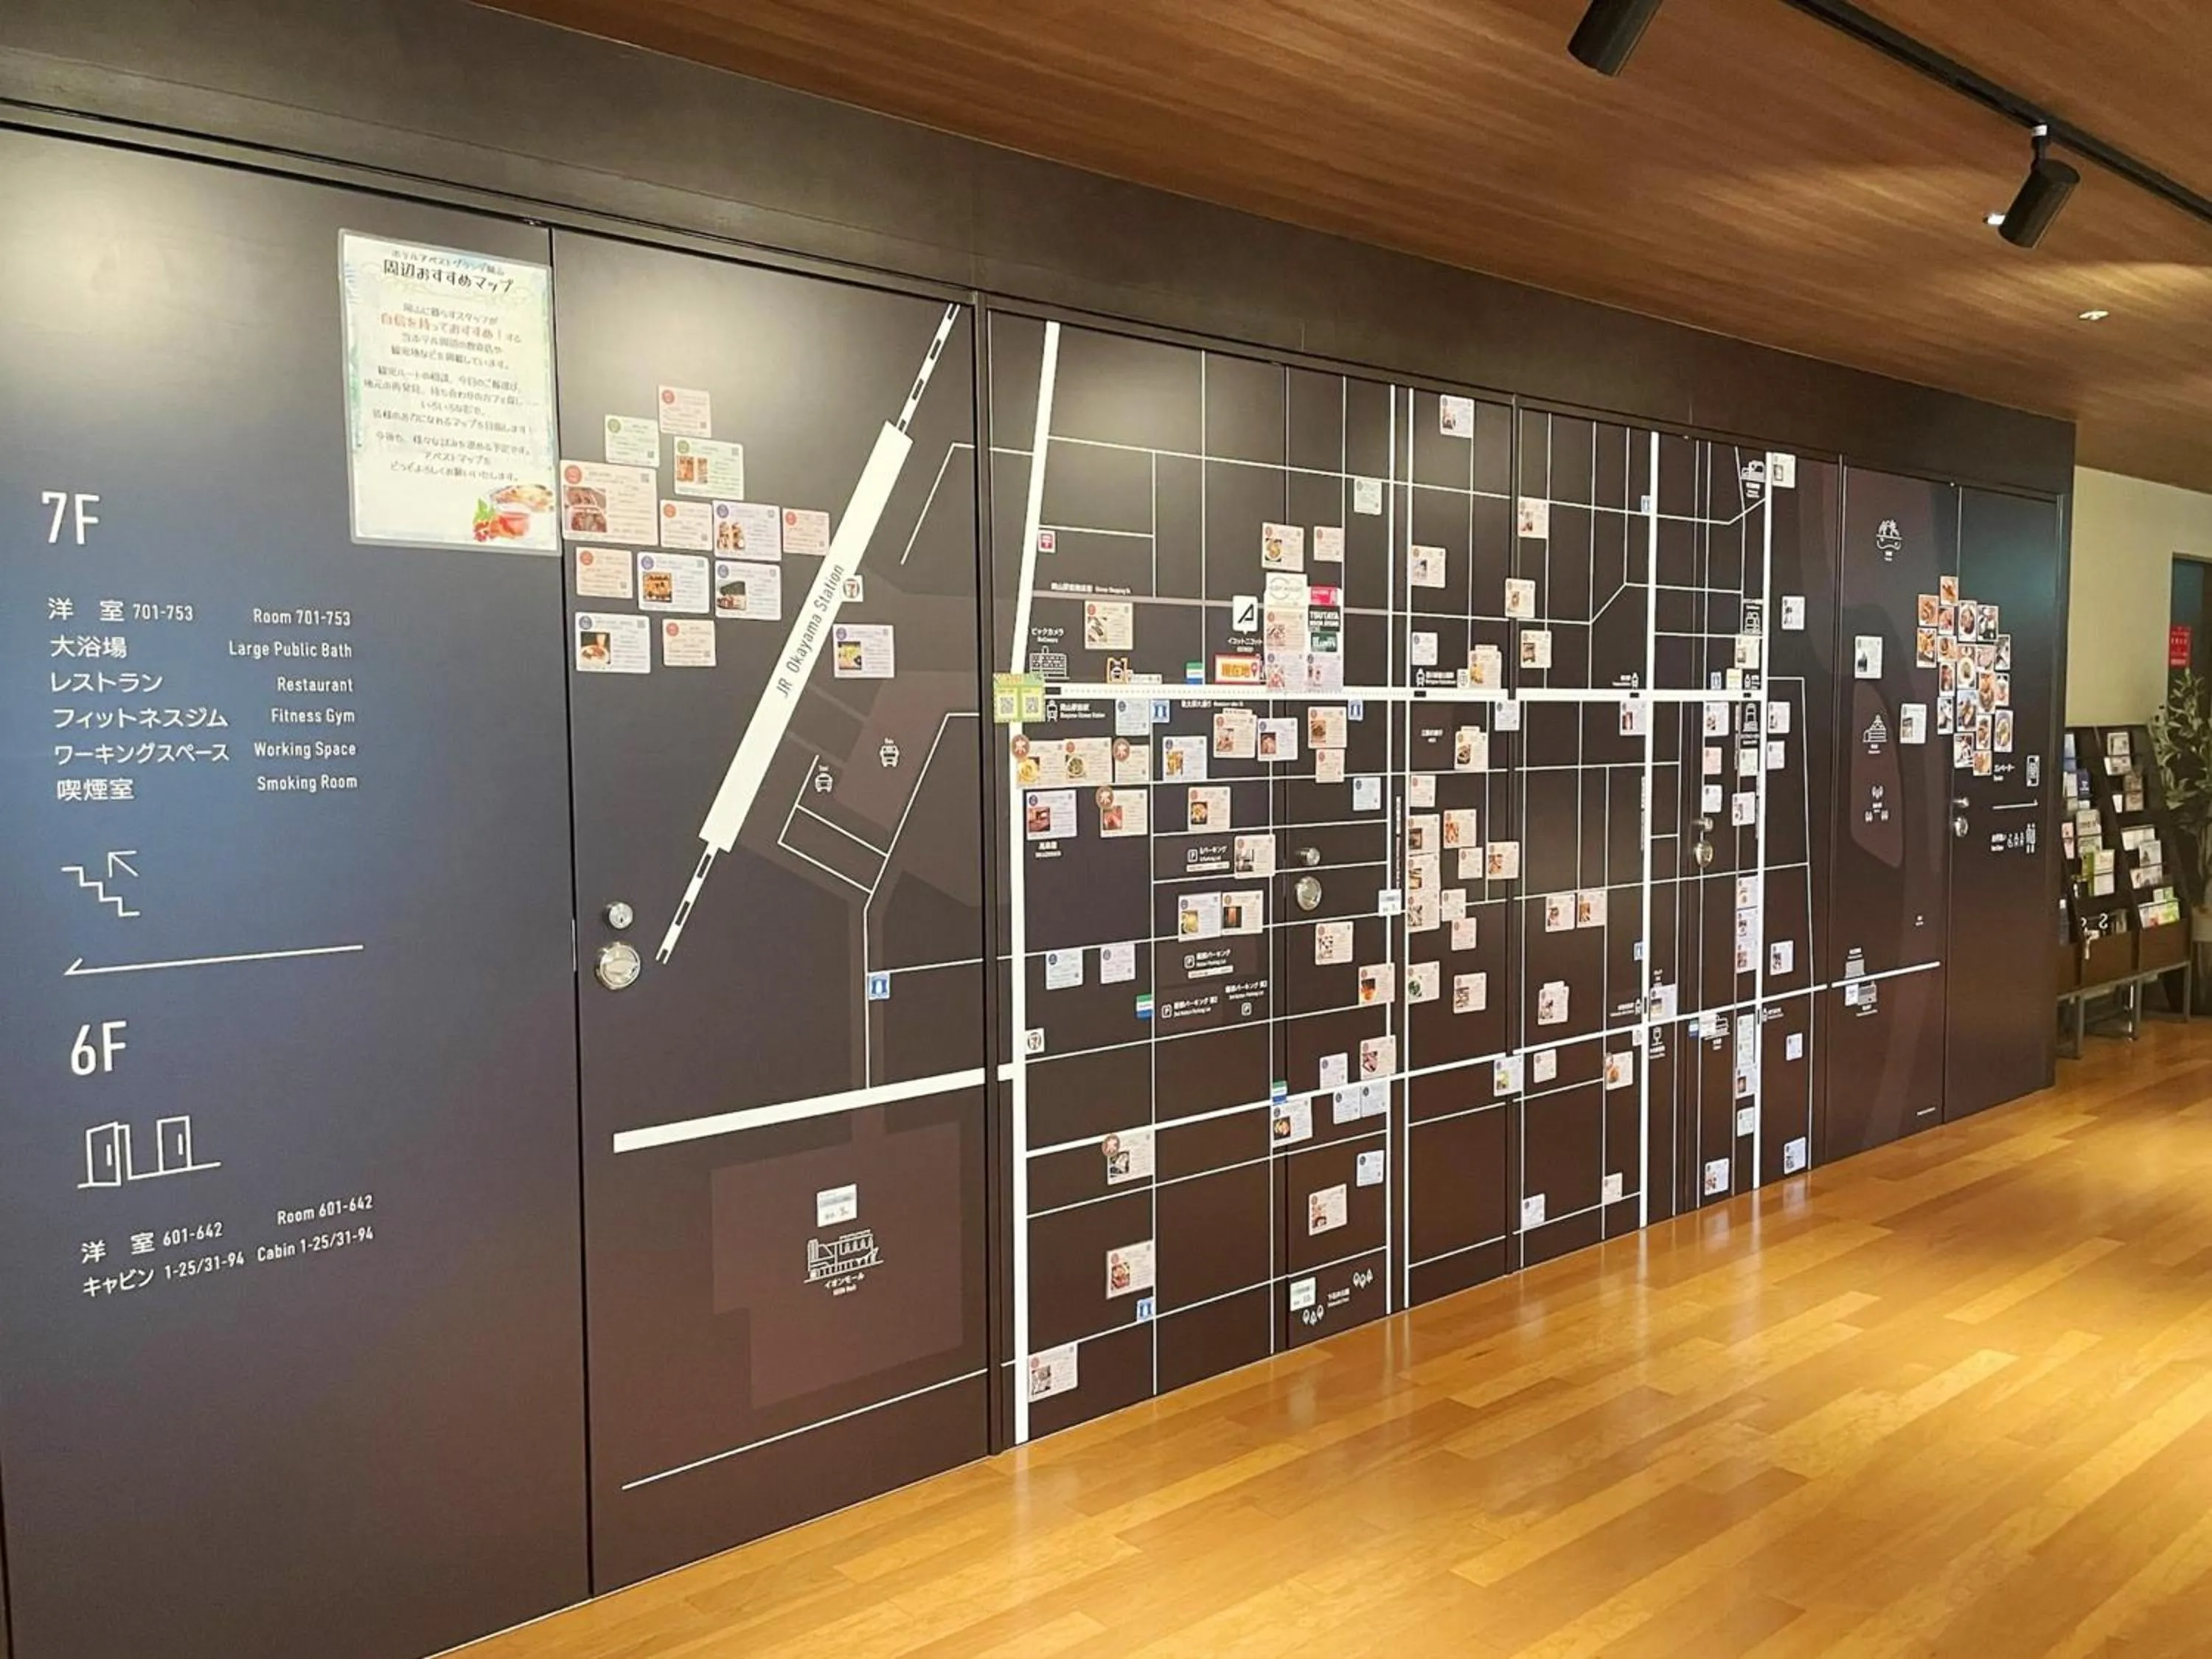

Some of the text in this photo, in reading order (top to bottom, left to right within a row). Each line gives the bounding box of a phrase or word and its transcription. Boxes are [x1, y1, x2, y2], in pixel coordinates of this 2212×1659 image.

[383, 259, 514, 293] 周辺おすすめマップ
[42, 491, 100, 545] 7F
[132, 603, 193, 622] 701-753
[253, 608, 350, 626] Room 701-753
[776, 564, 844, 698] JR Okayama Station
[50, 634, 127, 658] 大浴場
[229, 640, 352, 660] Large Public Bath
[51, 672, 163, 693] レストラン
[277, 676, 352, 692] Restaurant
[53, 707, 229, 729] フィットネスジム
[271, 708, 355, 726] Fitness Gym
[55, 742, 229, 765] ワーキングスペース
[254, 741, 356, 759] Working Space
[57, 778, 134, 801] 喫煙室
[257, 773, 358, 793] Smoking Room
[71, 1020, 127, 1076] 6F
[277, 1194, 372, 1225] Room 601-642
[163, 1222, 222, 1246] 601-642
[257, 1226, 373, 1262] Cabin 1-25/31-94
[83, 1251, 244, 1297] キャビン 1-25/31-94
